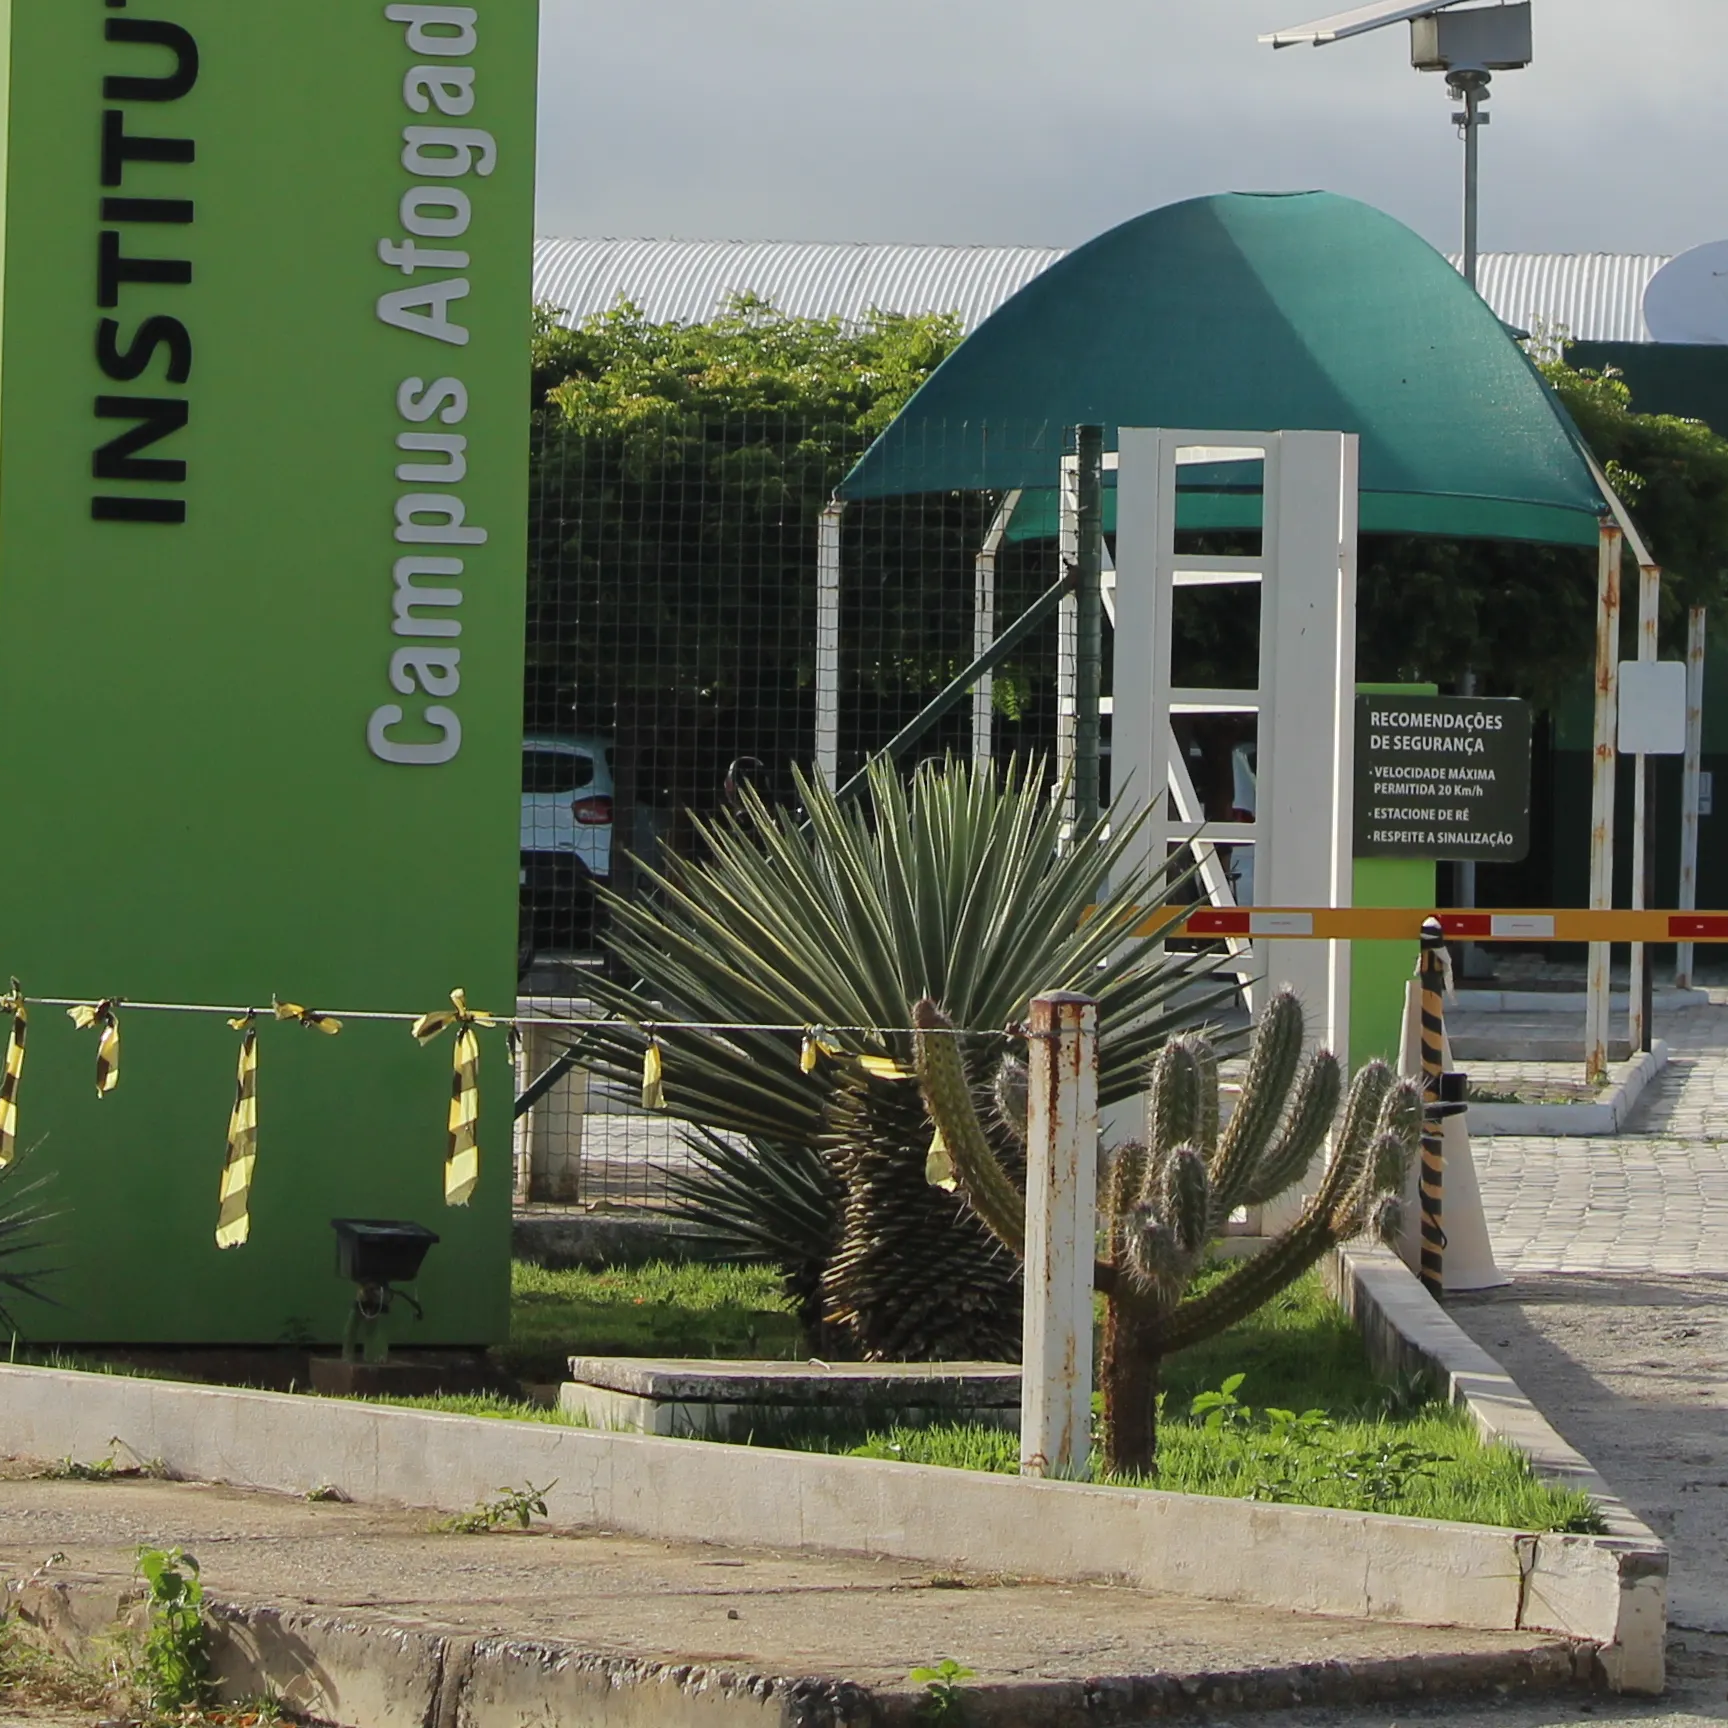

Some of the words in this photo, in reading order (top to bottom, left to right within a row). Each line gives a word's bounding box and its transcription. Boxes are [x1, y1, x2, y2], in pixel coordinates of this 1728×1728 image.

[366, 376, 488, 765] Campus
[1370, 711, 1502, 732] RECOMENDAÇÕES
[1370, 735, 1390, 749] DE
[1393, 736, 1484, 755] SEGURANÇA
[1375, 766, 1445, 779] VELOCIDADE
[1448, 766, 1495, 780] MÁXIMA
[1374, 783, 1434, 795] PERMITIDA
[1438, 784, 1451, 795] 20
[1454, 784, 1482, 796] Km/h
[1374, 808, 1434, 820] ESTACIONE
[1438, 809, 1452, 820] DE
[1455, 808, 1469, 820] RÉ
[1373, 830, 1423, 842] RESPEITE
[1426, 832, 1434, 843] A
[1437, 831, 1512, 847] SINALIZAÇÃO
